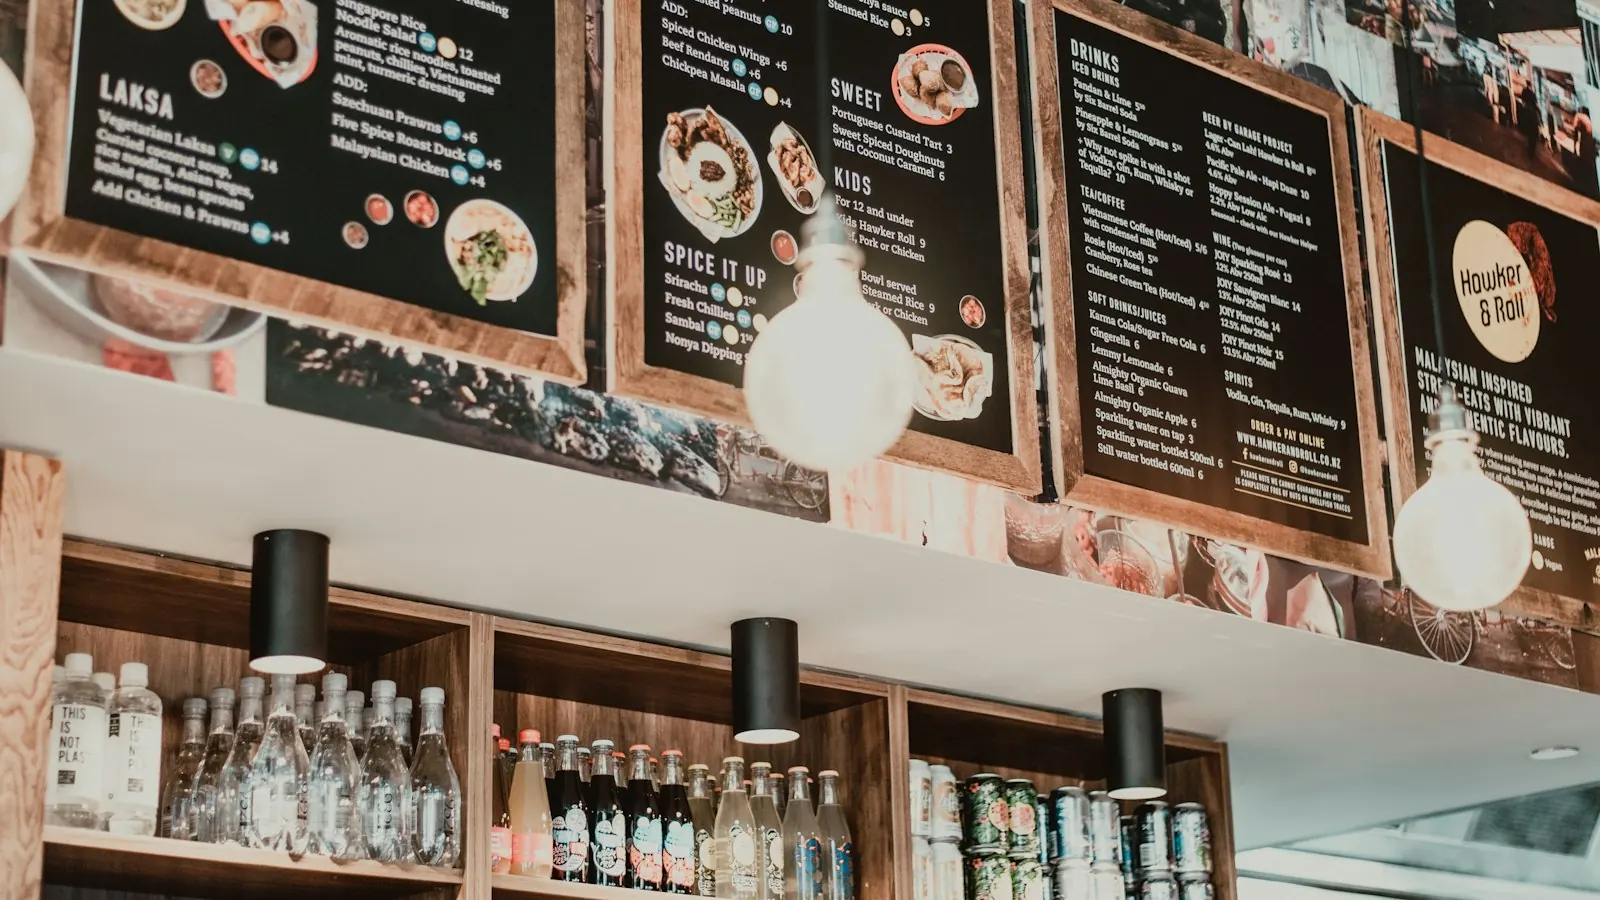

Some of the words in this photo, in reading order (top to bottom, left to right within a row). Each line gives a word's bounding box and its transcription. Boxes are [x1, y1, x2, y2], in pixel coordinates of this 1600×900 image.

[662, 1, 688, 18] ADD:
[722, 2, 762, 25] peanuts
[781, 23, 792, 35] 10
[828, 0, 868, 21] Steamed
[870, 13, 889, 28] Rice
[906, 27, 912, 36] 3
[336, 9, 381, 32] Noodle
[382, 25, 417, 44] Salad
[459, 48, 474, 62] 12
[662, 18, 694, 39] Spiced
[697, 31, 737, 53] Chicken
[739, 45, 770, 66] Wings
[775, 61, 787, 71] +6
[334, 40, 385, 64] peanuts,
[386, 56, 429, 78] chillies,
[430, 68, 495, 95] Vietnamese
[335, 25, 387, 50] Aromatic
[389, 44, 411, 57] rice
[412, 52, 458, 74] noodles,
[460, 66, 501, 85] toasted
[662, 36, 684, 52] Beef
[686, 45, 729, 71] Rendang
[749, 69, 761, 79] +6
[1071, 38, 1119, 73] DRINKS
[333, 73, 368, 92] ADD:
[662, 55, 708, 80] Chickpea
[710, 72, 746, 92] Masala
[780, 98, 792, 108] +4
[1072, 60, 1089, 76] ICED
[1092, 68, 1119, 88] DRINKS
[100, 72, 174, 120] LAKSA
[831, 77, 882, 112] SWEET
[1073, 77, 1103, 97] Pandan
[1104, 90, 1110, 100] &
[1112, 93, 1132, 108] Lime
[1074, 89, 1083, 102] by
[1084, 94, 1096, 106] Six
[1098, 99, 1119, 114] Barrel
[1120, 108, 1138, 122] Soda
[333, 93, 394, 120] Szechuan
[396, 111, 442, 134] Prawns
[462, 132, 478, 144] +6
[832, 105, 883, 131] Portuguese
[885, 125, 921, 145] Custard
[922, 136, 942, 151] Tart
[946, 144, 952, 154] 3
[1075, 106, 1113, 129] Pineapple
[1115, 122, 1121, 132] &
[1122, 124, 1169, 150] Lemongrass
[1202, 111, 1221, 128] BEER
[1223, 119, 1232, 132] BY
[1234, 124, 1261, 143] GARAGE
[1263, 134, 1293, 155] PROJECT
[98, 108, 173, 144] Vegetarian
[175, 132, 216, 156] Laksa
[260, 158, 278, 174] 14
[332, 113, 359, 131] Five
[361, 122, 394, 142] Spice
[397, 132, 432, 150] Roast
[434, 143, 466, 162] Duck
[486, 159, 502, 171] +6
[833, 123, 861, 141] Sweet
[863, 134, 893, 152] Spiced
[895, 144, 945, 168] Doughnuts
[331, 135, 397, 164] Malaysian
[399, 155, 450, 178] Chicken
[470, 176, 486, 188] +4
[833, 138, 855, 152] with
[857, 145, 895, 165] Coconut
[897, 158, 935, 178] Caramel
[939, 171, 945, 180] 6
[835, 166, 871, 196] KIDS
[1080, 184, 1125, 211] TEA/COFFEE
[92, 180, 124, 199] Add
[124, 189, 181, 216] Chicken
[184, 204, 197, 218] &
[198, 209, 249, 234] Prawns
[271, 230, 290, 244] +4
[835, 194, 851, 207] For
[852, 200, 864, 212] 12
[867, 205, 884, 219] and
[887, 211, 914, 228] under
[859, 220, 895, 240] Hawker
[898, 231, 915, 245] Roll
[920, 238, 926, 248] 9
[1082, 202, 1128, 228] Vietnamese
[1130, 220, 1154, 236] Coffee
[1155, 228, 1192, 252] (Hot/Iced)
[1195, 243, 1208, 255] 5/6
[1083, 217, 1100, 229] with
[1101, 224, 1138, 244] condensed
[1140, 238, 1157, 249] milk
[664, 240, 715, 276] SPICE
[723, 258, 738, 281] IT
[745, 265, 766, 289] UP
[859, 234, 878, 249] Pork
[880, 243, 890, 252] or
[891, 245, 925, 262] Chicken
[665, 273, 708, 295] Sriracha
[861, 270, 884, 286] Bowl
[886, 279, 917, 295] served
[1460, 262, 1522, 296] Hawker
[665, 293, 694, 310] Fresh
[696, 301, 735, 321] Chillies
[862, 285, 902, 305] Steamed
[905, 297, 925, 311] Rice
[929, 303, 935, 313] 9
[1088, 290, 1107, 306] SOFT
[1109, 298, 1166, 325] DRINKS/JUICES
[1480, 299, 1491, 327] &
[1495, 292, 1525, 323] Roll
[665, 312, 705, 332] Sambal
[1090, 326, 1130, 348] Gingerella
[1134, 340, 1140, 350] 6
[665, 332, 699, 351] Nonya
[701, 341, 742, 365] Dipping
[1091, 343, 1121, 363] Lemmy
[1123, 353, 1164, 374] Lemonade
[1168, 367, 1173, 376] 6
[1238, 338, 1256, 352] Pinot
[1257, 344, 1272, 358] Noir
[1275, 349, 1284, 360] 15
[1225, 370, 1253, 388] SPIRITS
[1481, 370, 1532, 404] INSPIRED
[1095, 391, 1131, 412] Almighty
[1133, 402, 1163, 419] Organic
[1165, 412, 1188, 426] Apple
[1191, 419, 1197, 428] 6
[1494, 396, 1522, 423] WITH
[1524, 407, 1571, 439] VIBRANT
[1237, 431, 1341, 469] WWW.HAWKERANDROLL.CO.NZ
[1251, 419, 1274, 435] ORDER
[1284, 428, 1297, 443] PAY
[1299, 432, 1325, 449] ONLINE
[1509, 423, 1570, 459] FLAVOURS.
[1098, 443, 1114, 456] Still
[1116, 448, 1139, 462] water
[1140, 454, 1168, 470] bottled
[1170, 462, 1194, 478] 600ml
[1198, 470, 1204, 480] 6
[60, 721, 71, 733] IS
[62, 707, 86, 720] THIS
[60, 737, 80, 748] NOT
